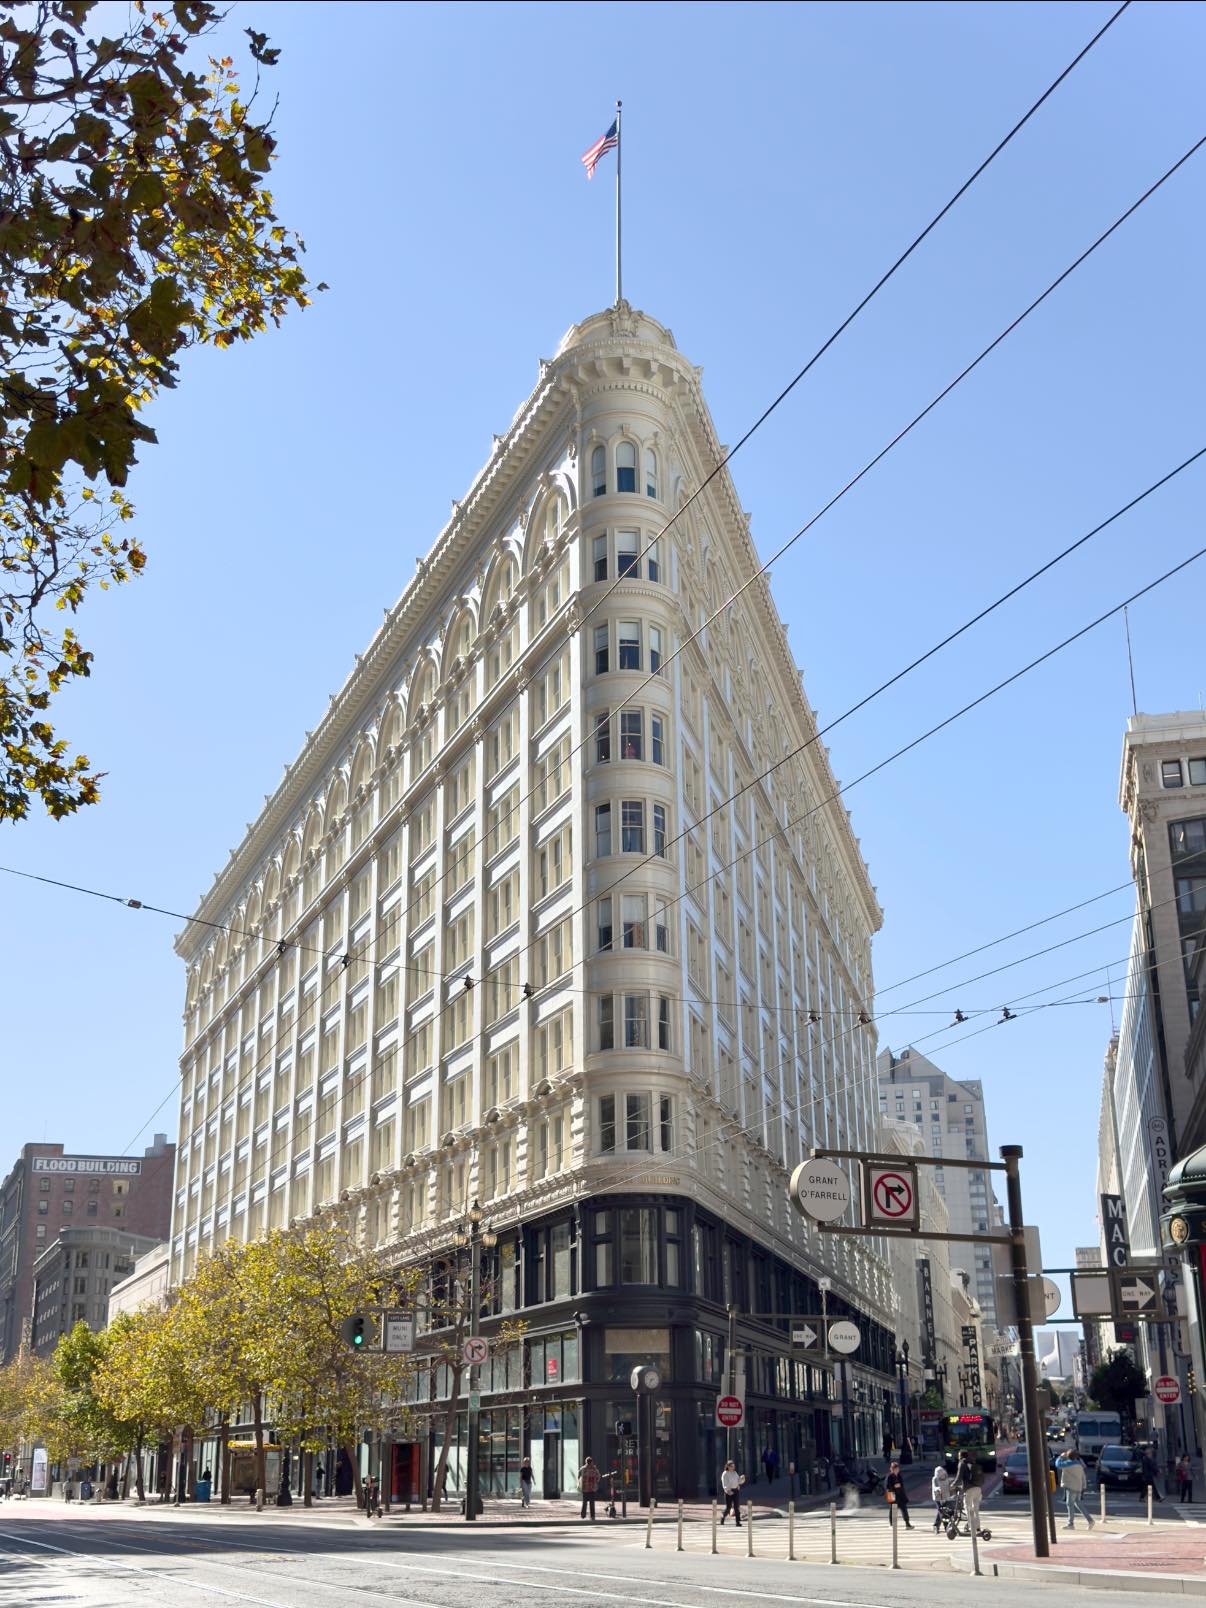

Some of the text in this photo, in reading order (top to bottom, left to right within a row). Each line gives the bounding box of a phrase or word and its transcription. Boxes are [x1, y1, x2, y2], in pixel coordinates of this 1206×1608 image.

[36, 1159, 138, 1173] FLOOD BUILDING
[809, 1176, 838, 1184] GRANT
[801, 1190, 847, 1200] O'FARRELL
[969, 1339, 981, 1402] PARKING
